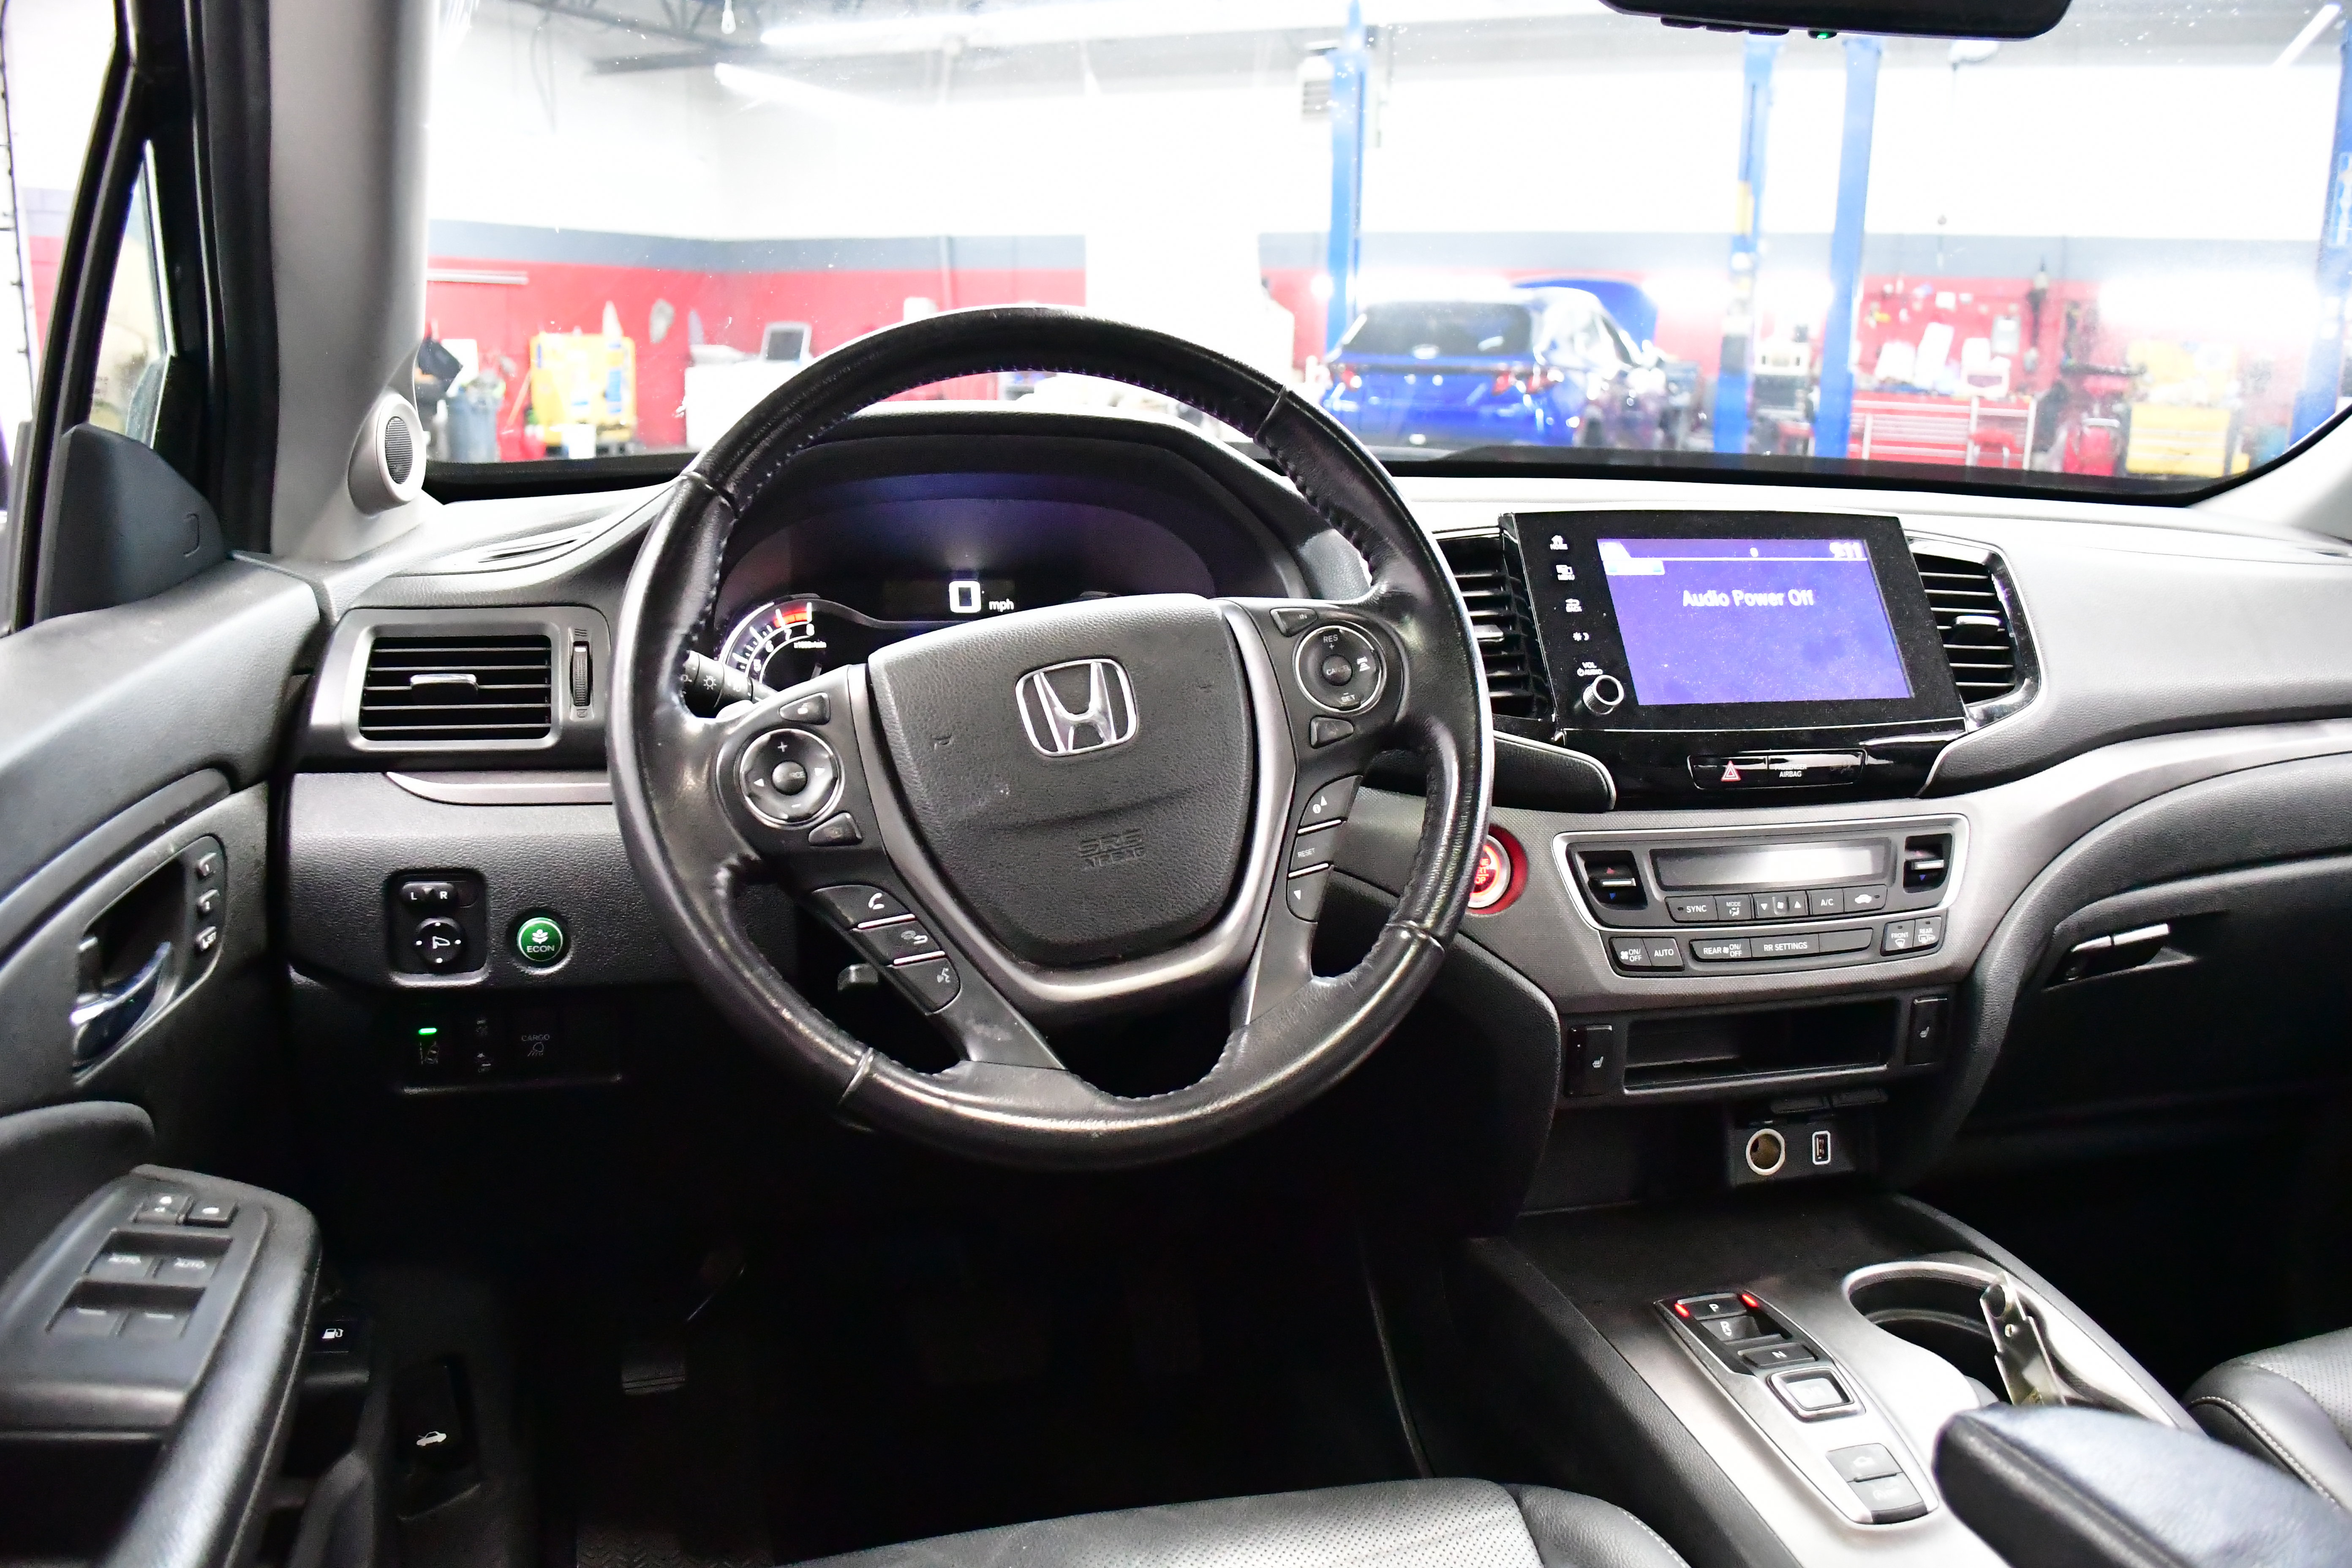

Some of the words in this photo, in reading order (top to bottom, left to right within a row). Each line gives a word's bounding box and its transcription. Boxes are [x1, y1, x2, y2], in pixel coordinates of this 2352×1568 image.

[1683, 590, 1729, 607] Audio
[1732, 590, 1784, 607] Power
[1788, 588, 1815, 606] Off
[989, 598, 1014, 612] mph
[806, 623, 815, 636] 8
[784, 628, 792, 641] 7
[1323, 634, 1338, 643] RES
[765, 640, 774, 653] 6
[753, 659, 762, 672] 5
[1341, 694, 1356, 702] SET
[1297, 848, 1315, 858] RESET
[411, 892, 418, 900] L
[440, 891, 448, 899] R
[1820, 898, 1834, 906] A/C
[1686, 904, 1707, 913] SYNC
[527, 945, 555, 953] ECON
[1703, 947, 1722, 955] REAR
[1775, 942, 1808, 951] SETTINGS
[1654, 949, 1674, 957] AUTO
[1709, 1303, 1719, 1312] P
[1720, 1321, 1731, 1333] R
[1772, 1350, 1787, 1358] N
